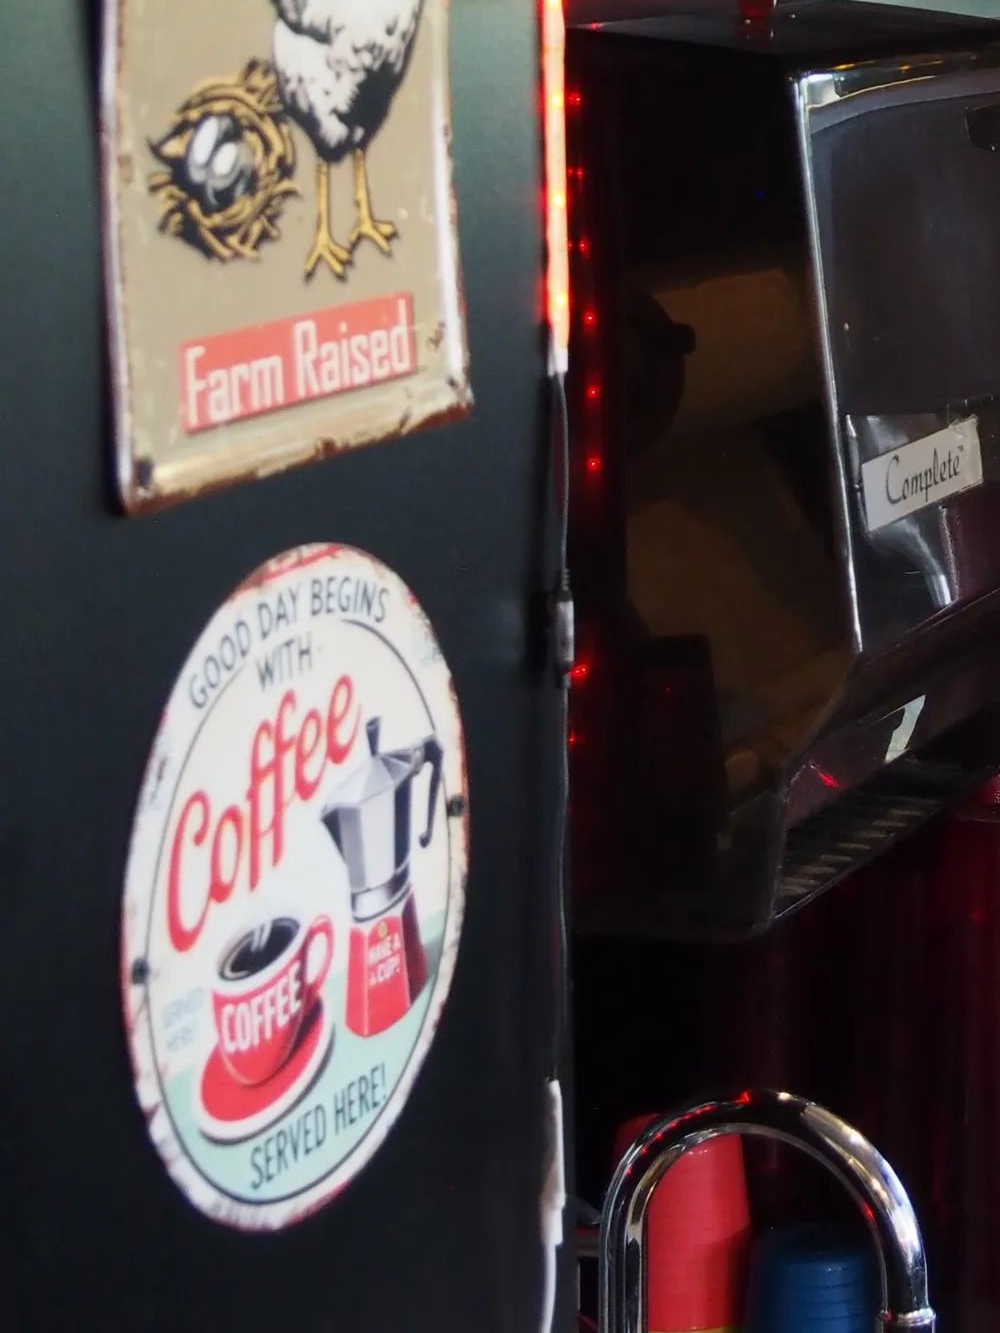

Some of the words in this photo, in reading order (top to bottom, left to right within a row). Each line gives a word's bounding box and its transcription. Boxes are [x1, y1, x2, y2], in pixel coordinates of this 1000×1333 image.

[185, 346, 284, 427] Farm
[294, 297, 412, 398] Raised
[189, 621, 252, 709] GOOD
[257, 583, 302, 640] DAY
[311, 576, 390, 623] BEGINS
[256, 632, 313, 692] WITH
[167, 674, 362, 952] Coffee
[221, 961, 303, 1054] COFFEE
[250, 1104, 326, 1191] SERVED
[334, 1062, 388, 1138] HERE!
